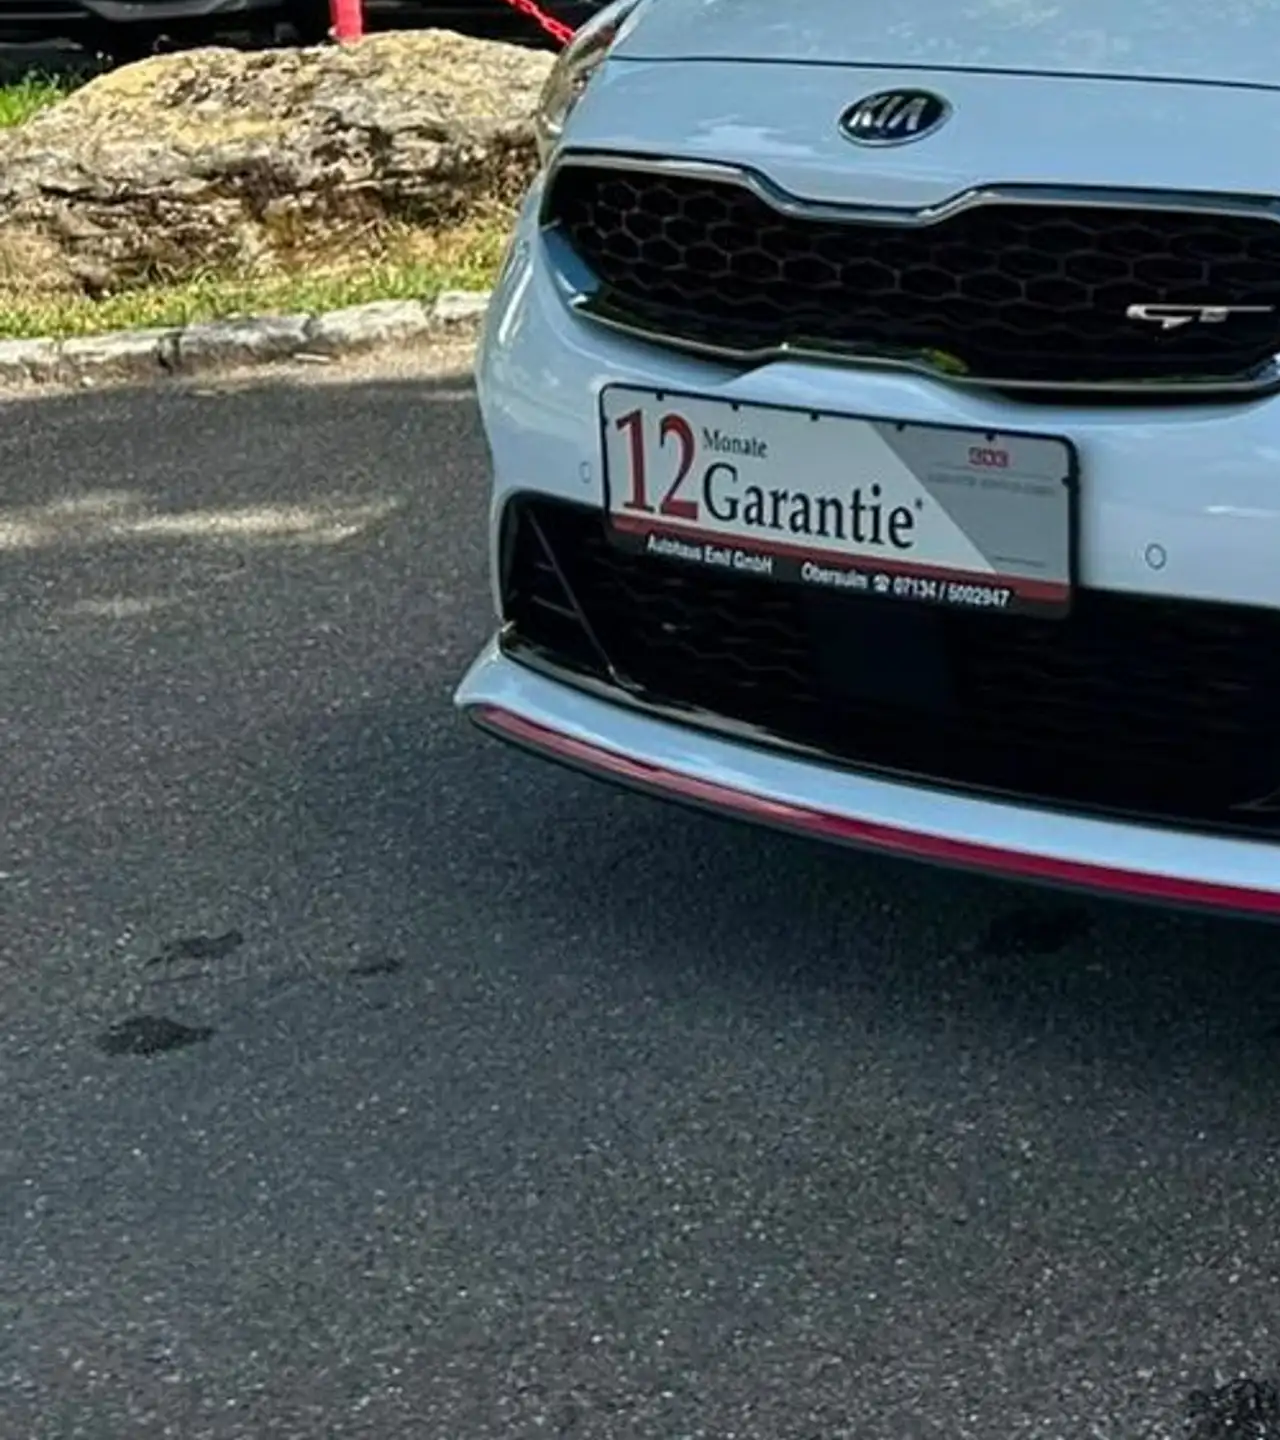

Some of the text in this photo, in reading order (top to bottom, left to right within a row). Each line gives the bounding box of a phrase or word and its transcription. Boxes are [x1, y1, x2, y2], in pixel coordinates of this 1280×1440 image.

[847, 95, 928, 132] KIA
[703, 426, 768, 460] Monate
[615, 409, 699, 522] 12
